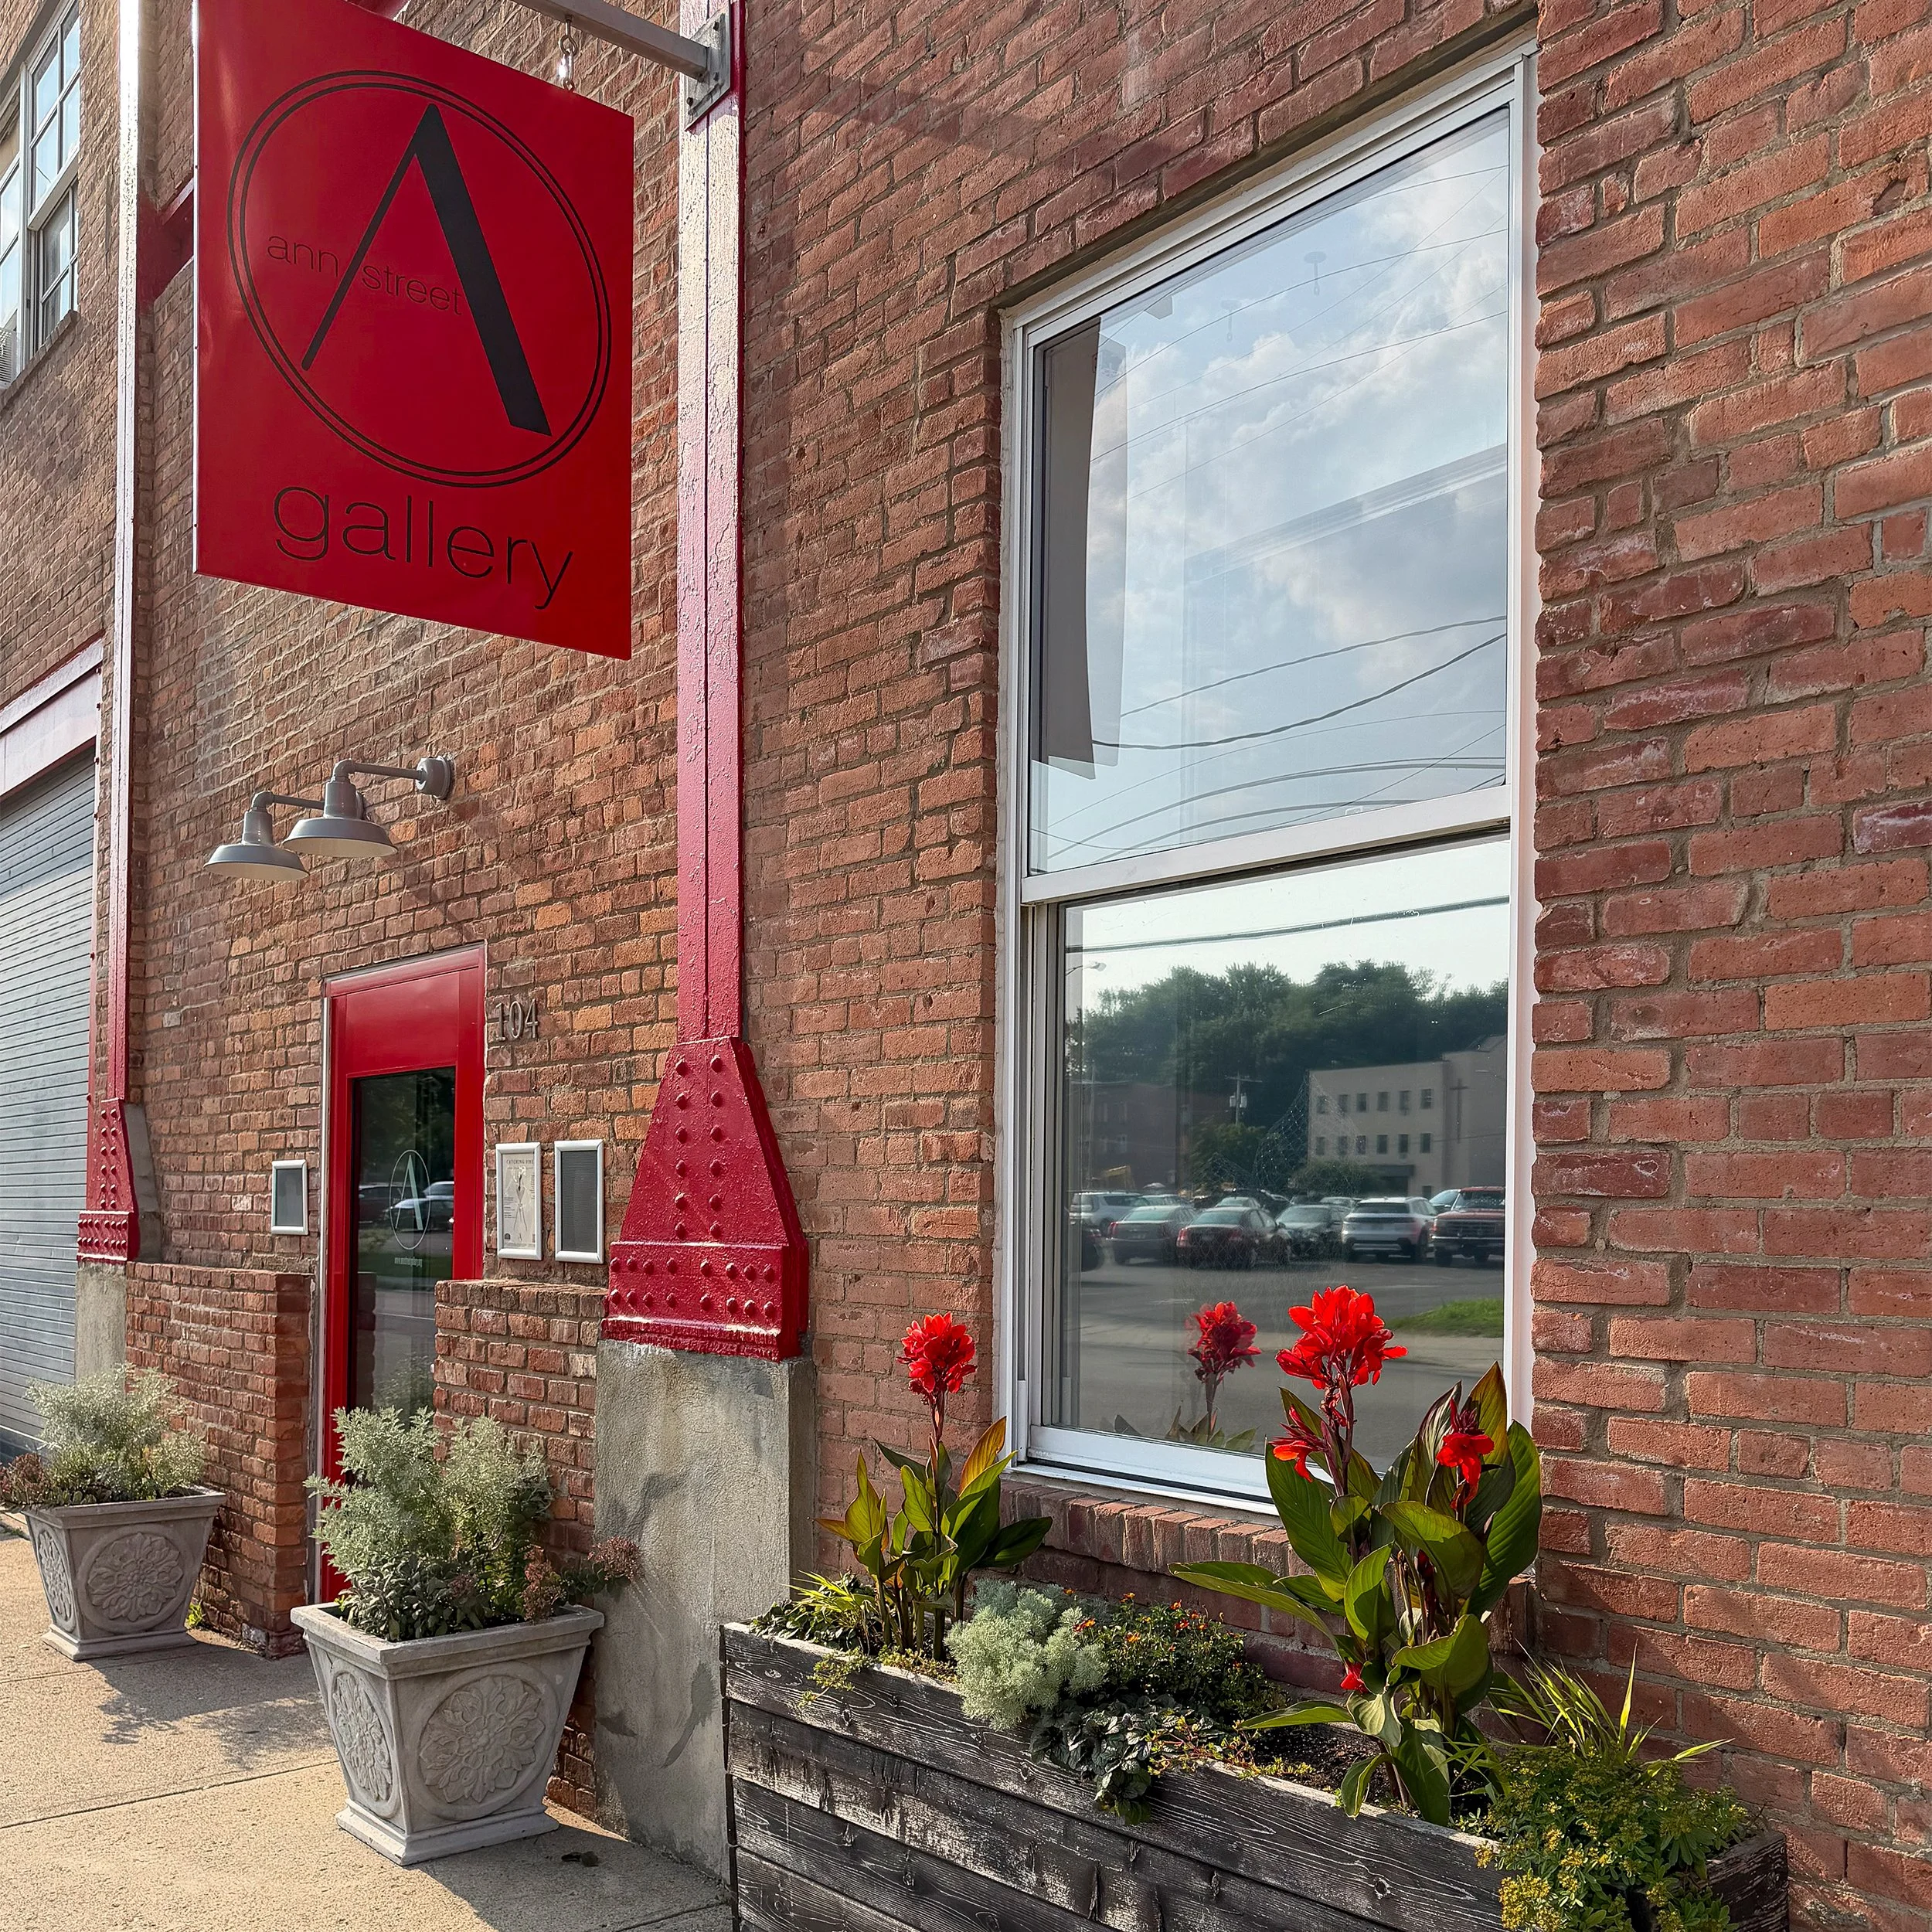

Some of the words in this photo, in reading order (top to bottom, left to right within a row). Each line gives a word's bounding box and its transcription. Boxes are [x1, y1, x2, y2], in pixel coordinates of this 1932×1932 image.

[267, 235, 338, 277] ann
[361, 264, 462, 316] street
[302, 103, 552, 436] A
[273, 485, 573, 611] gallery
[495, 998, 539, 1041] 104
